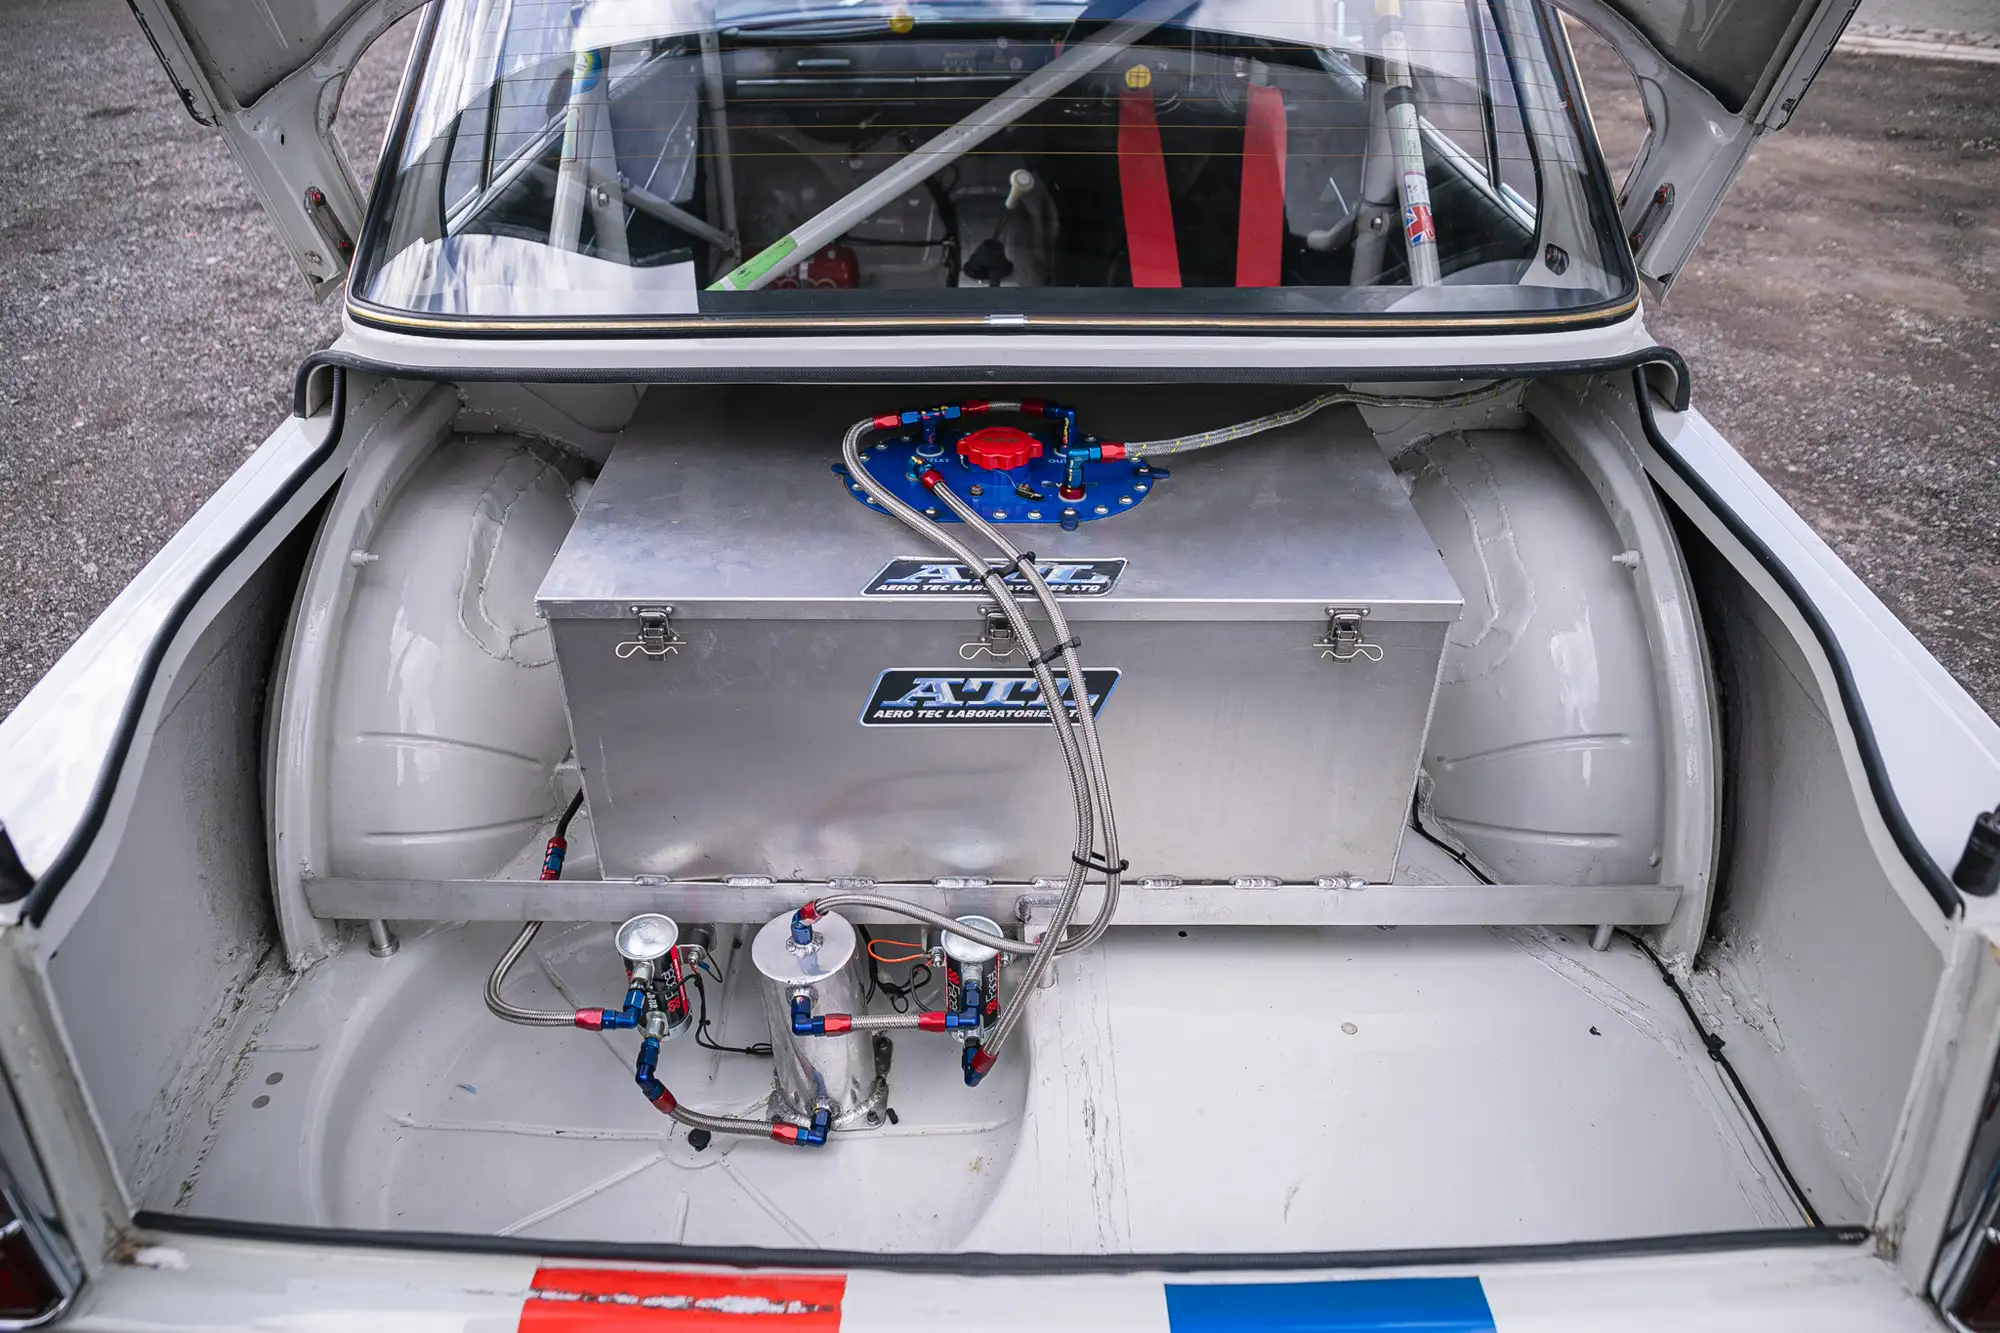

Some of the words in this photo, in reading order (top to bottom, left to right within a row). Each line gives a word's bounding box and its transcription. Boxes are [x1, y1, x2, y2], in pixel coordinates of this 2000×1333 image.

[873, 710, 914, 719] AERO
[917, 710, 945, 719] TEC
[946, 710, 1051, 719] LABORATORIE
